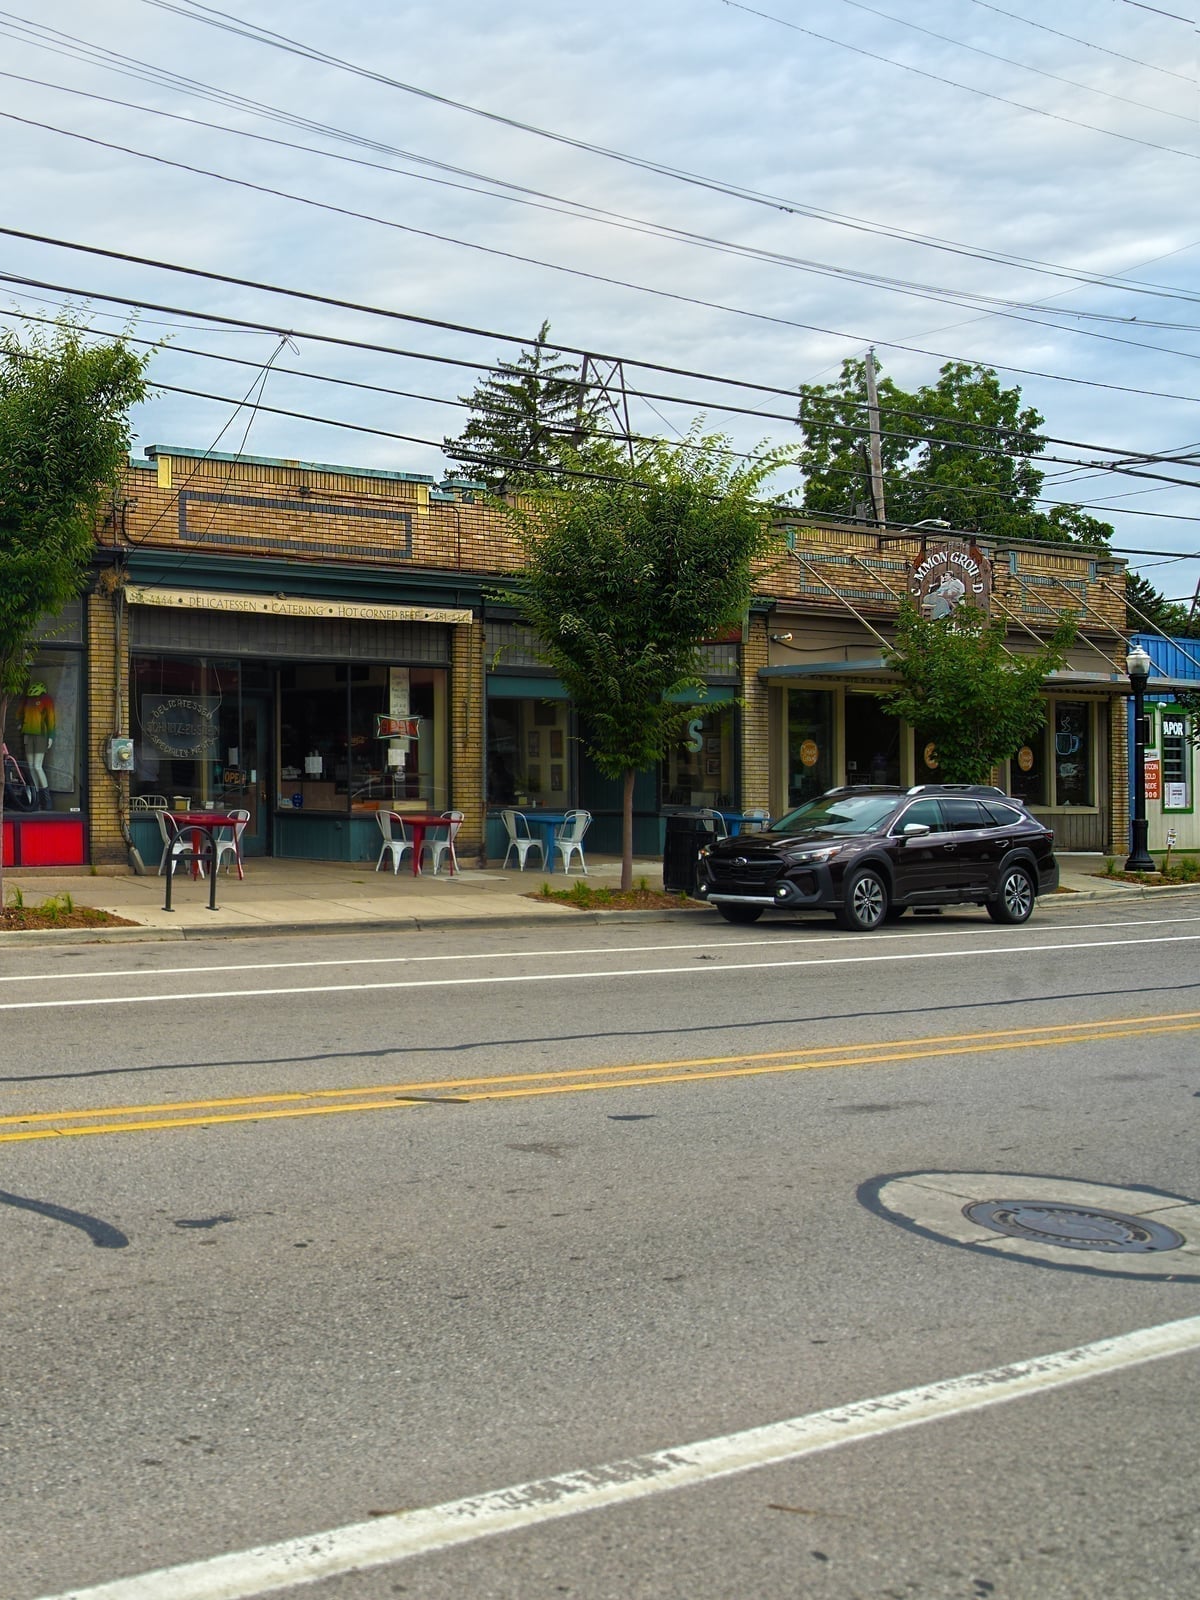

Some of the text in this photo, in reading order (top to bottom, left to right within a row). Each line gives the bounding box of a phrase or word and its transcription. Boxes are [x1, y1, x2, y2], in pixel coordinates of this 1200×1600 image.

[911, 551, 983, 597] CMMON GROUD
[189, 597, 257, 611] DELICATESSEN
[272, 602, 323, 616] CATERING
[338, 605, 358, 617] HOT
[360, 608, 397, 620] CORNED
[400, 609, 421, 620] BEEF
[152, 736, 188, 757] SPECIALTY
